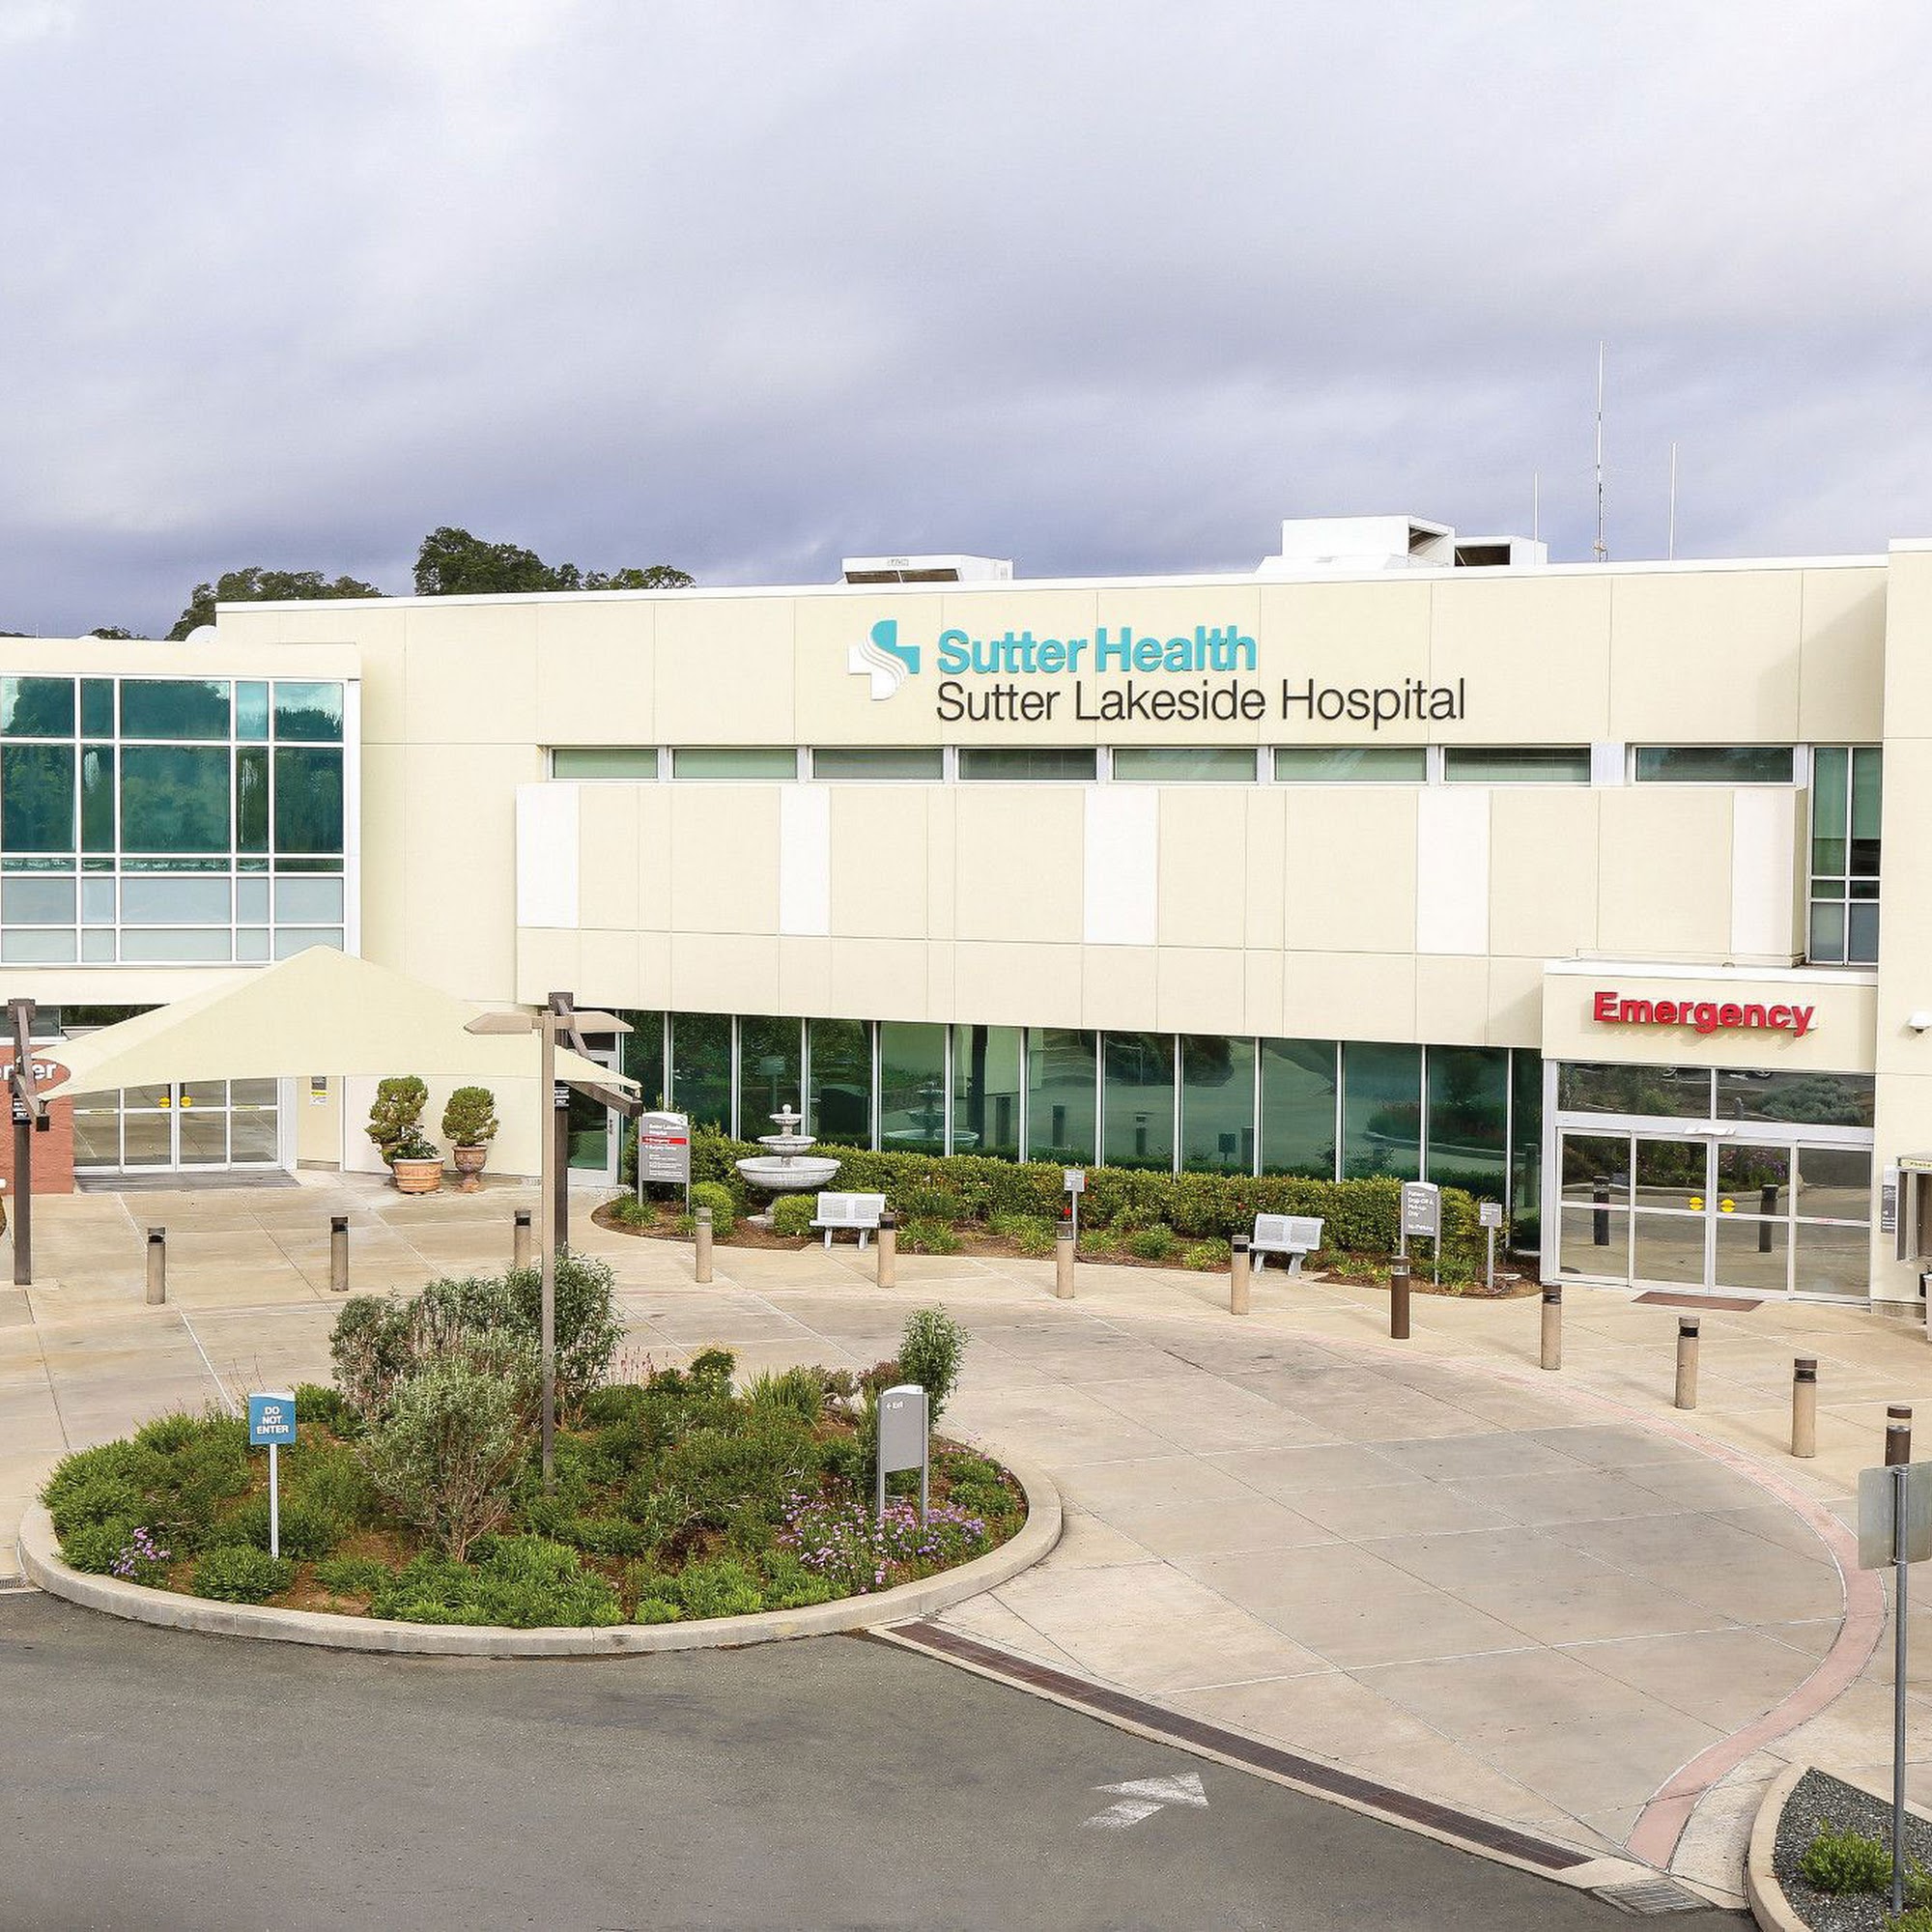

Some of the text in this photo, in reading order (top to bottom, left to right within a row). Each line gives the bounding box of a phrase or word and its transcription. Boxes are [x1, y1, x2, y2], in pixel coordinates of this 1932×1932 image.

[937, 626, 1257, 674] Sutter Health
[936, 677, 1463, 730] Sutter Lakeside Hospital
[1594, 991, 1815, 1037] Emergency
[262, 1415, 283, 1425] NOT
[265, 1406, 280, 1415] DO
[256, 1425, 289, 1435] ENTER
